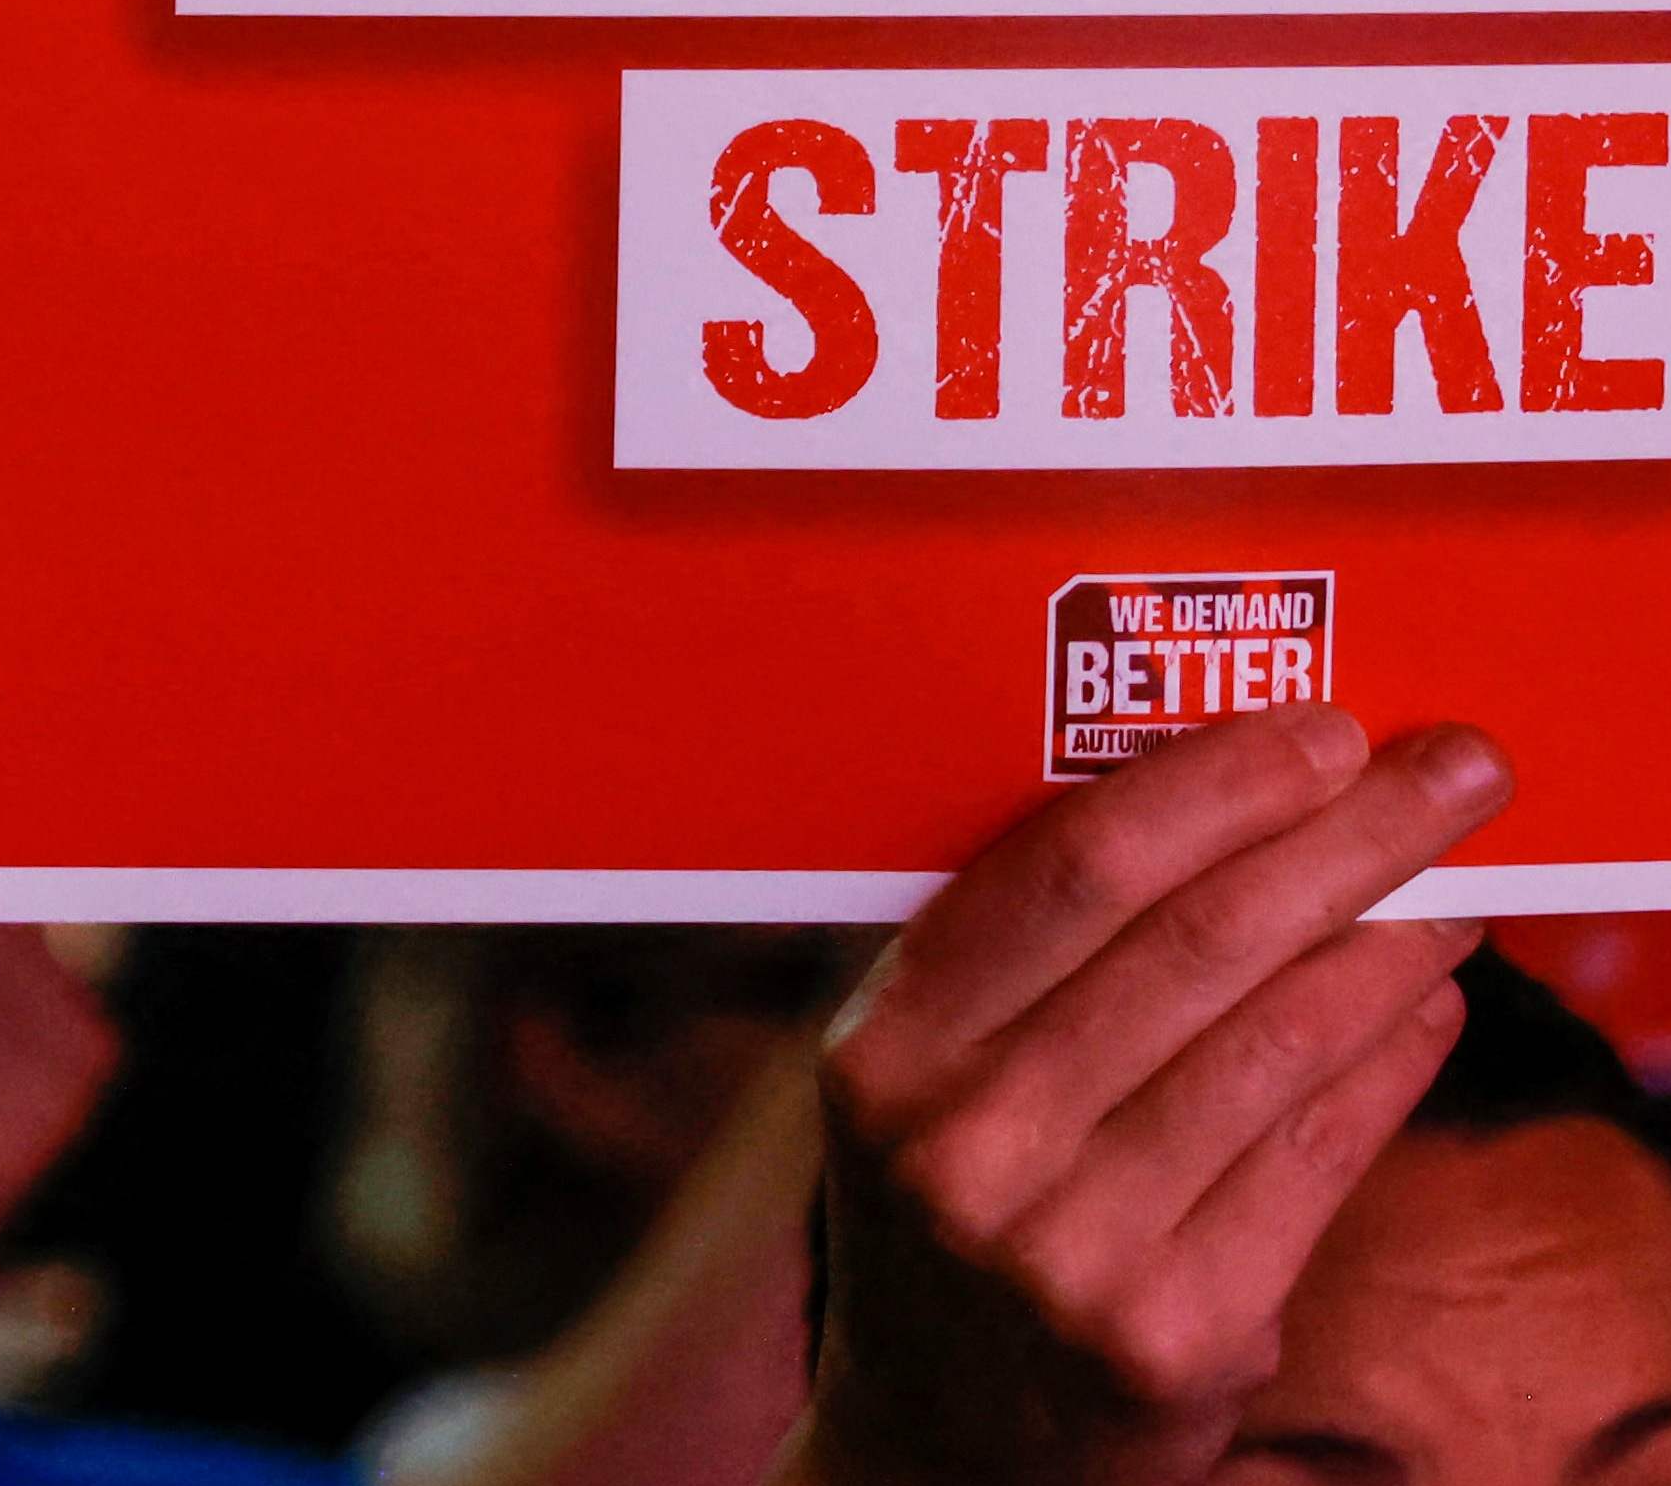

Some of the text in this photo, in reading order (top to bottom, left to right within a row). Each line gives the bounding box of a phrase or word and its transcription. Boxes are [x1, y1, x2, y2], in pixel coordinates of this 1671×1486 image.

[703, 113, 1668, 420] STRIKE
[1109, 593, 1314, 633] WE DEMAND
[1066, 638, 1312, 715] BETTER
